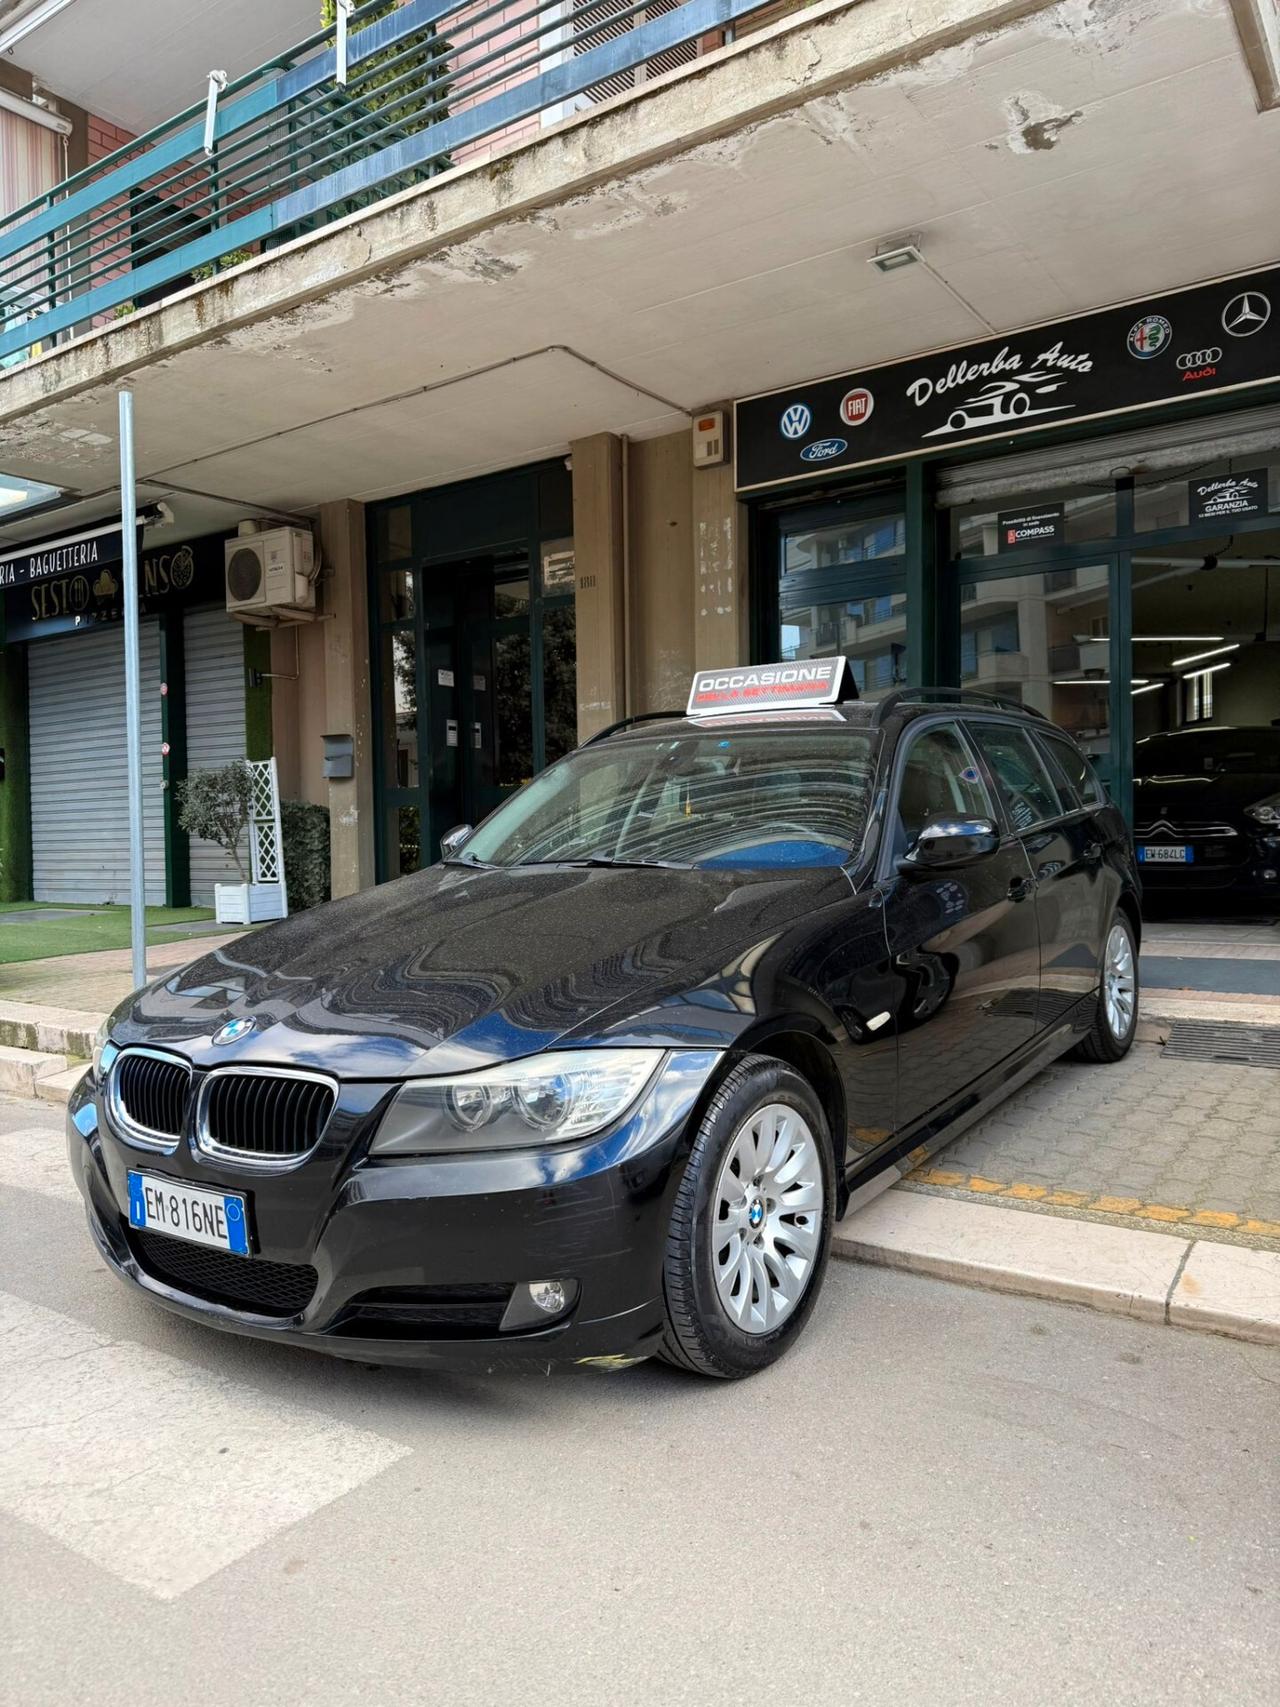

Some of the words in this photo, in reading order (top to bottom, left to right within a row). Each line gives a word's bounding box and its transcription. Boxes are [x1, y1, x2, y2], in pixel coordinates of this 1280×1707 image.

[1146, 317, 1170, 334] ROMEO
[906, 346, 1024, 406] Dellerba
[1030, 341, 1094, 373] Auto
[848, 398, 867, 417] FIAT
[809, 442, 839, 459] Ford
[1197, 478, 1237, 496] Dellerba
[1205, 499, 1249, 513] GARANZIA
[1015, 525, 1055, 538] COMPASS
[30, 540, 98, 578] BAGUETTERIA
[699, 666, 833, 692] OCCASIONE
